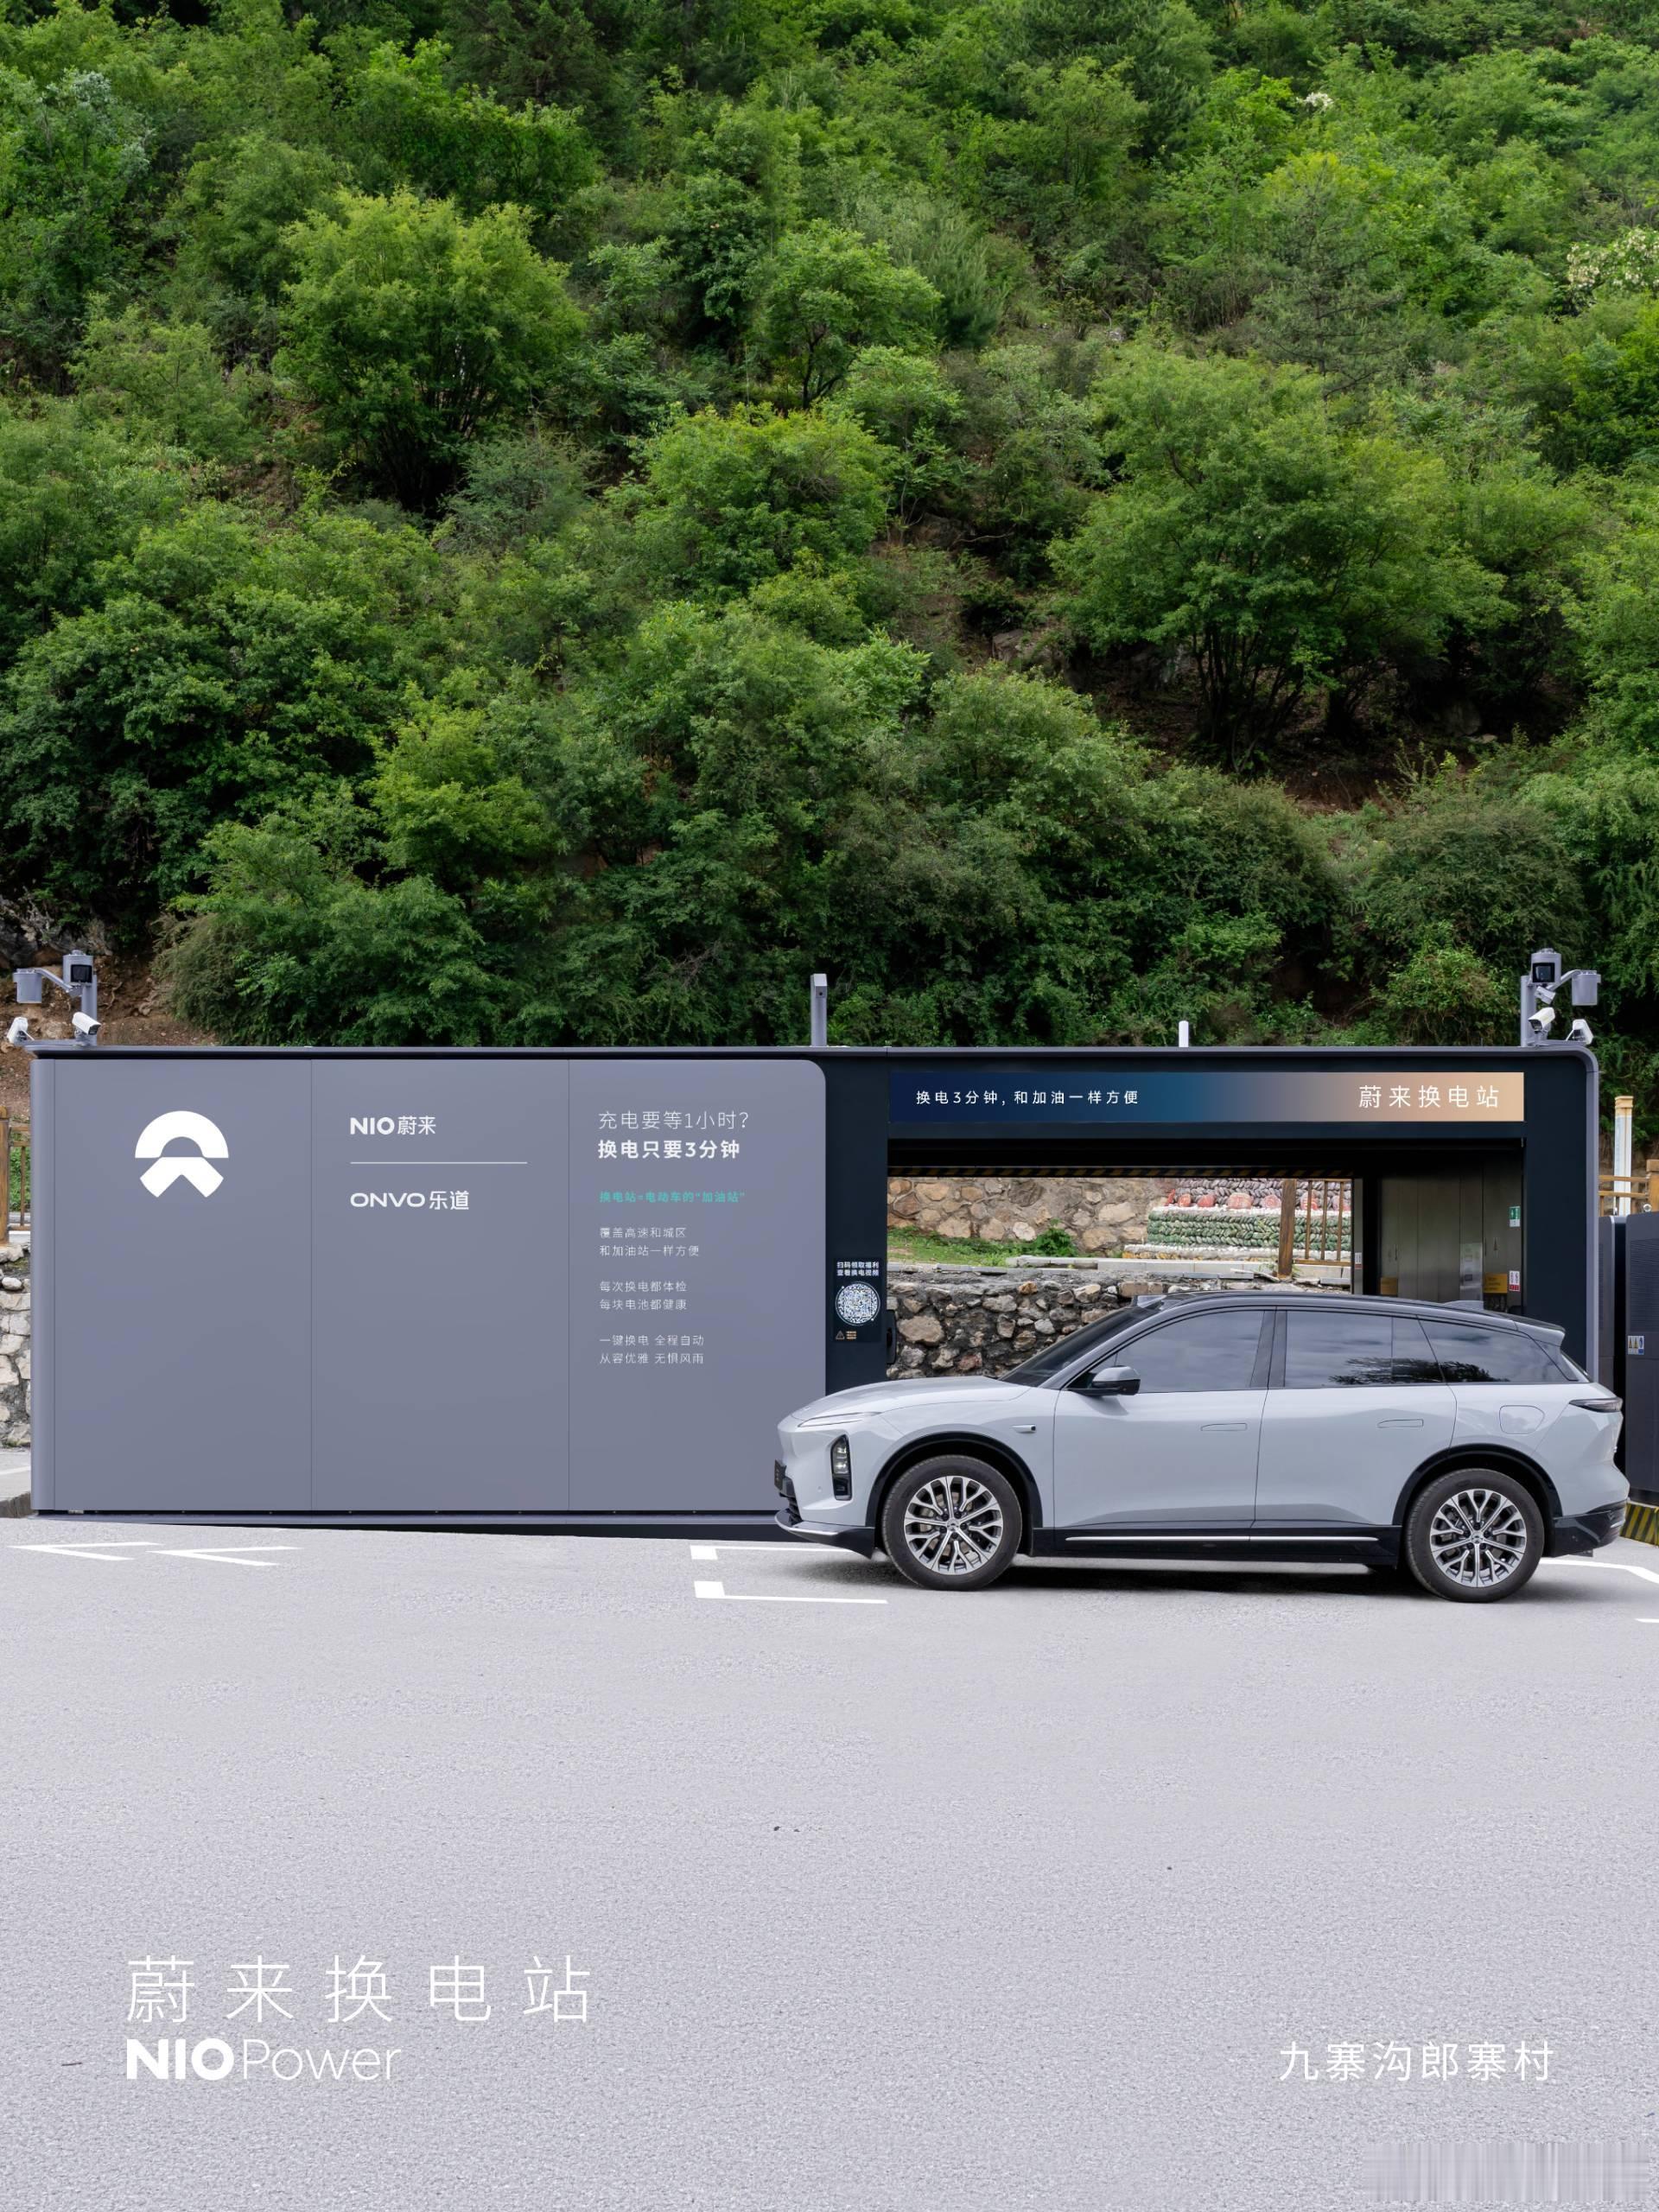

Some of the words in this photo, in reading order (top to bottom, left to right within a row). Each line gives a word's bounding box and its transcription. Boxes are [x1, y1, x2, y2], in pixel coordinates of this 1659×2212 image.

[1359, 1084, 1499, 1109] 蔚来换电站
[598, 1139, 741, 1159] 换电只要3分钟
[600, 1227, 687, 1238] 覆盖高速和城区
[600, 1245, 699, 1256] 和加油站一样方便
[600, 1281, 687, 1292] 每次换电都体检
[600, 1299, 687, 1310] 每块电池都健康
[600, 1334, 649, 1346] 一键换电
[654, 1334, 704, 1346] 全程自动
[600, 1352, 649, 1364] 从容优雅
[654, 1352, 703, 1364] 无惧风雨
